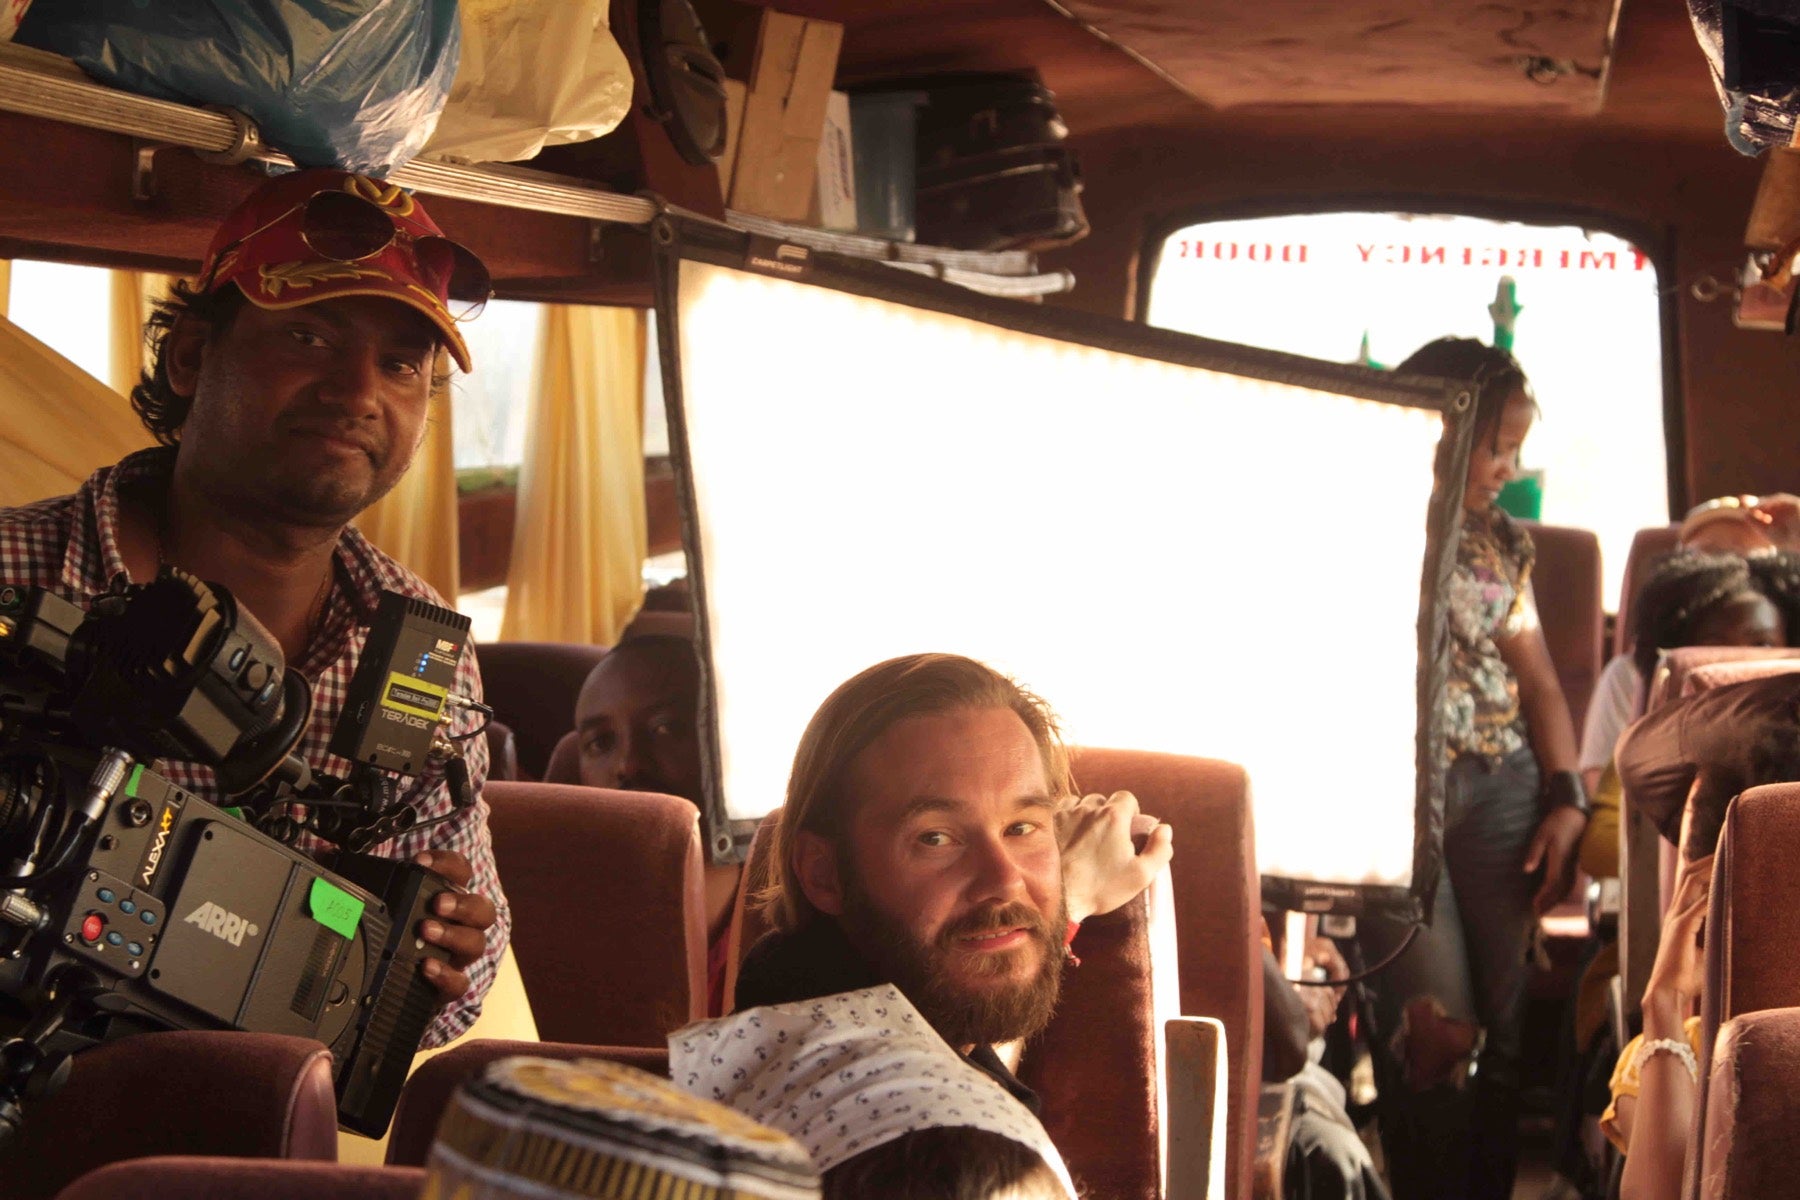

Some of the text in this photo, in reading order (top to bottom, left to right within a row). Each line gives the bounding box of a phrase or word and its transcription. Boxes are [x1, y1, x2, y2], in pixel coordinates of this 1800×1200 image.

[381, 708, 430, 731] TERADEK
[142, 830, 170, 886] ALEXA
[184, 900, 249, 948] ARRI
